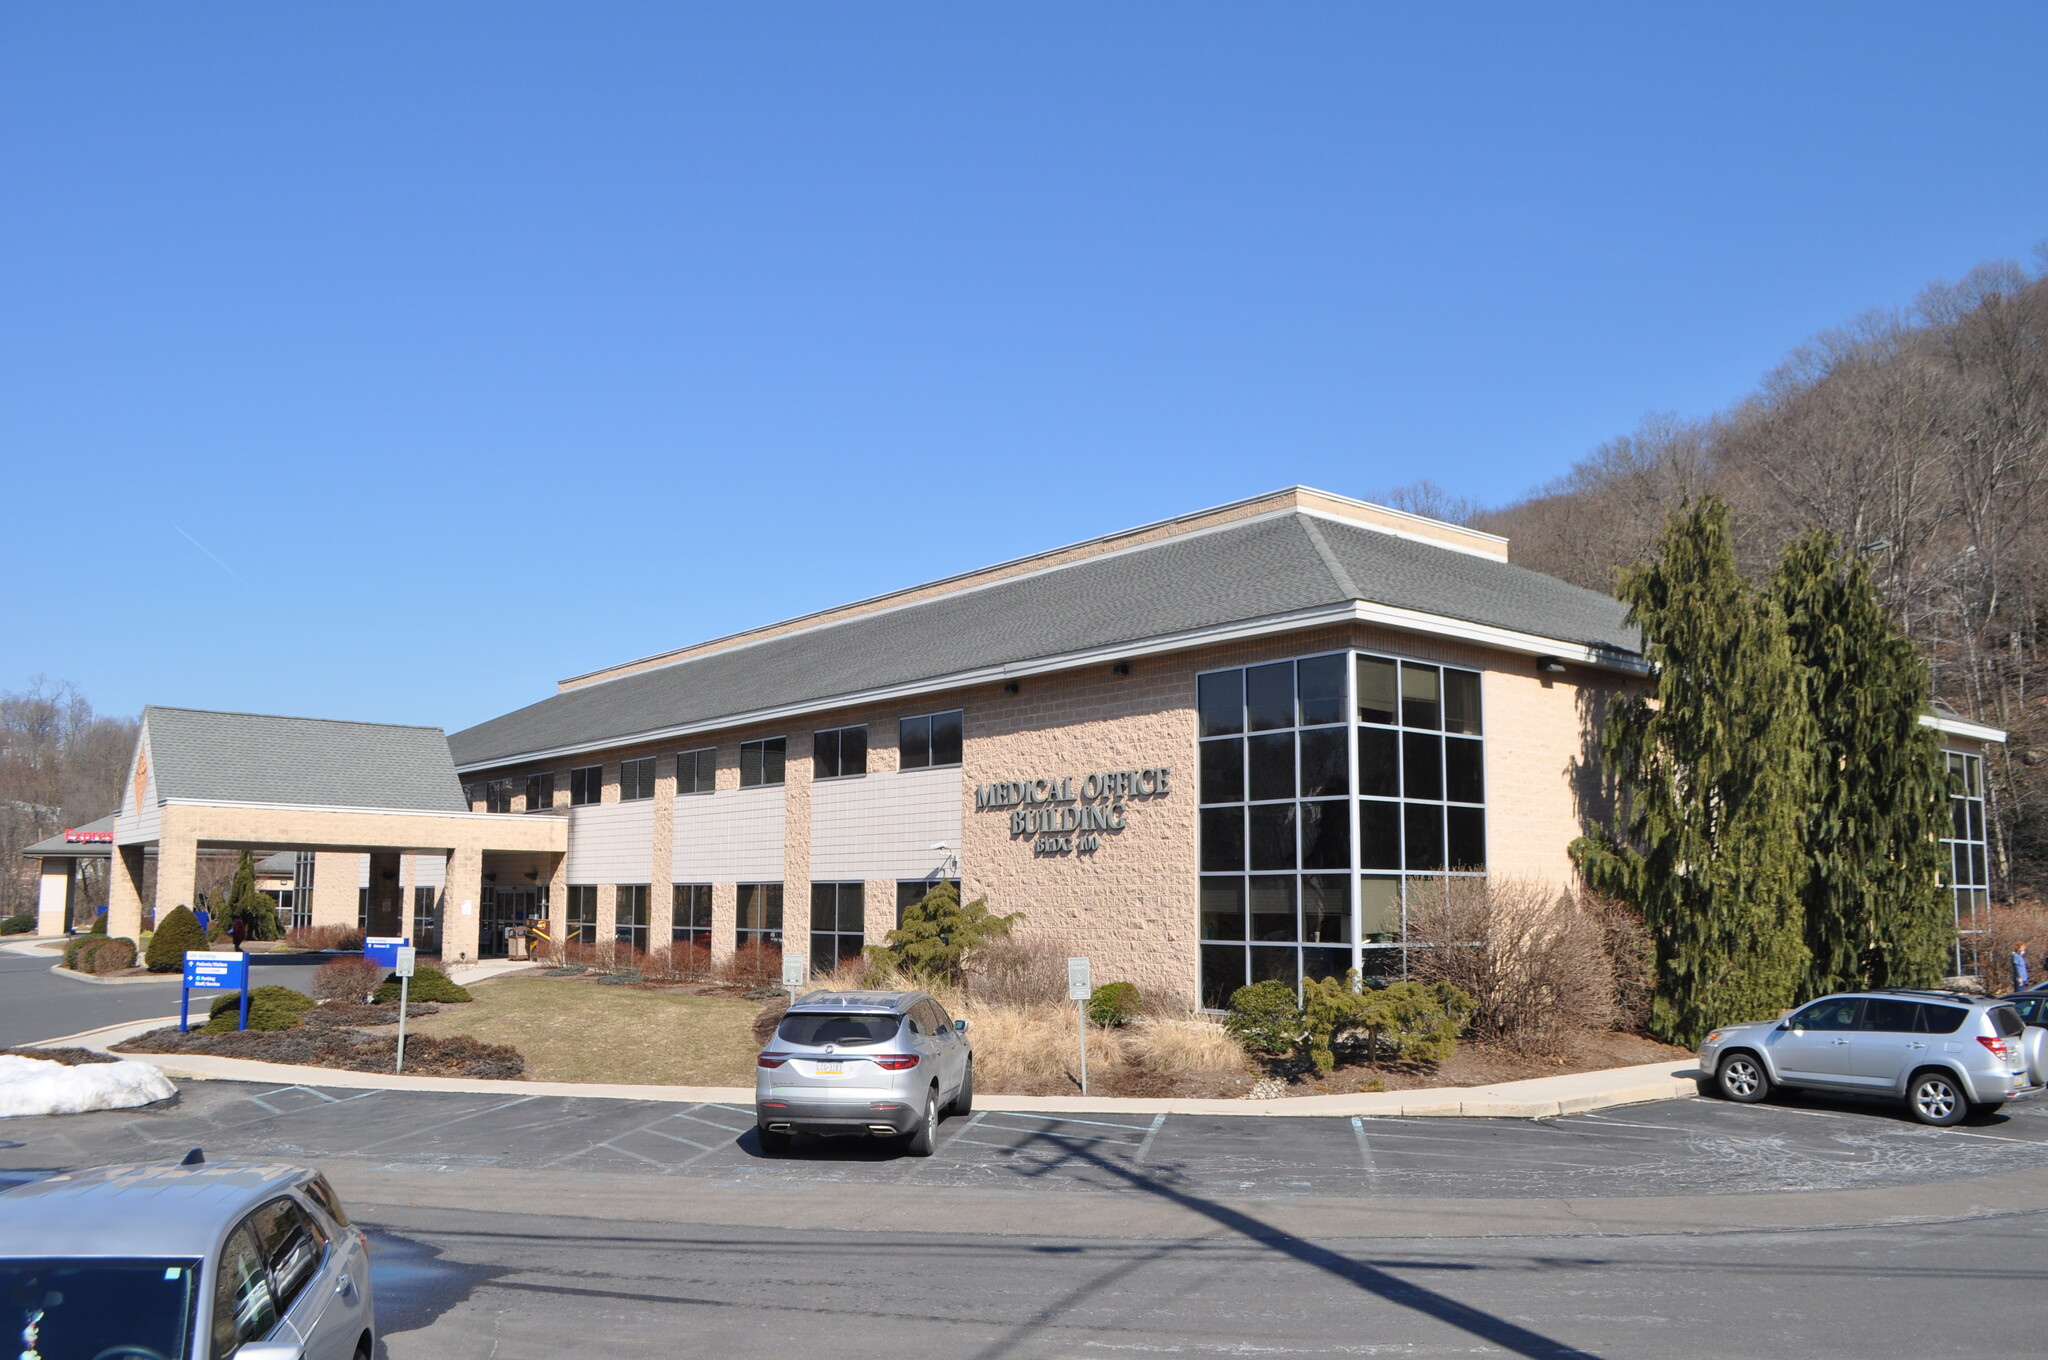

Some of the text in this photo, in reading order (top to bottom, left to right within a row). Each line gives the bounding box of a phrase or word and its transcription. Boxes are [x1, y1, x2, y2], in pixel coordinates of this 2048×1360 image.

[976, 767, 1171, 808] MEDICAL OFFICE
[1011, 803, 1126, 835] BUILDING
[1036, 836, 1099, 853] BLDG 100
